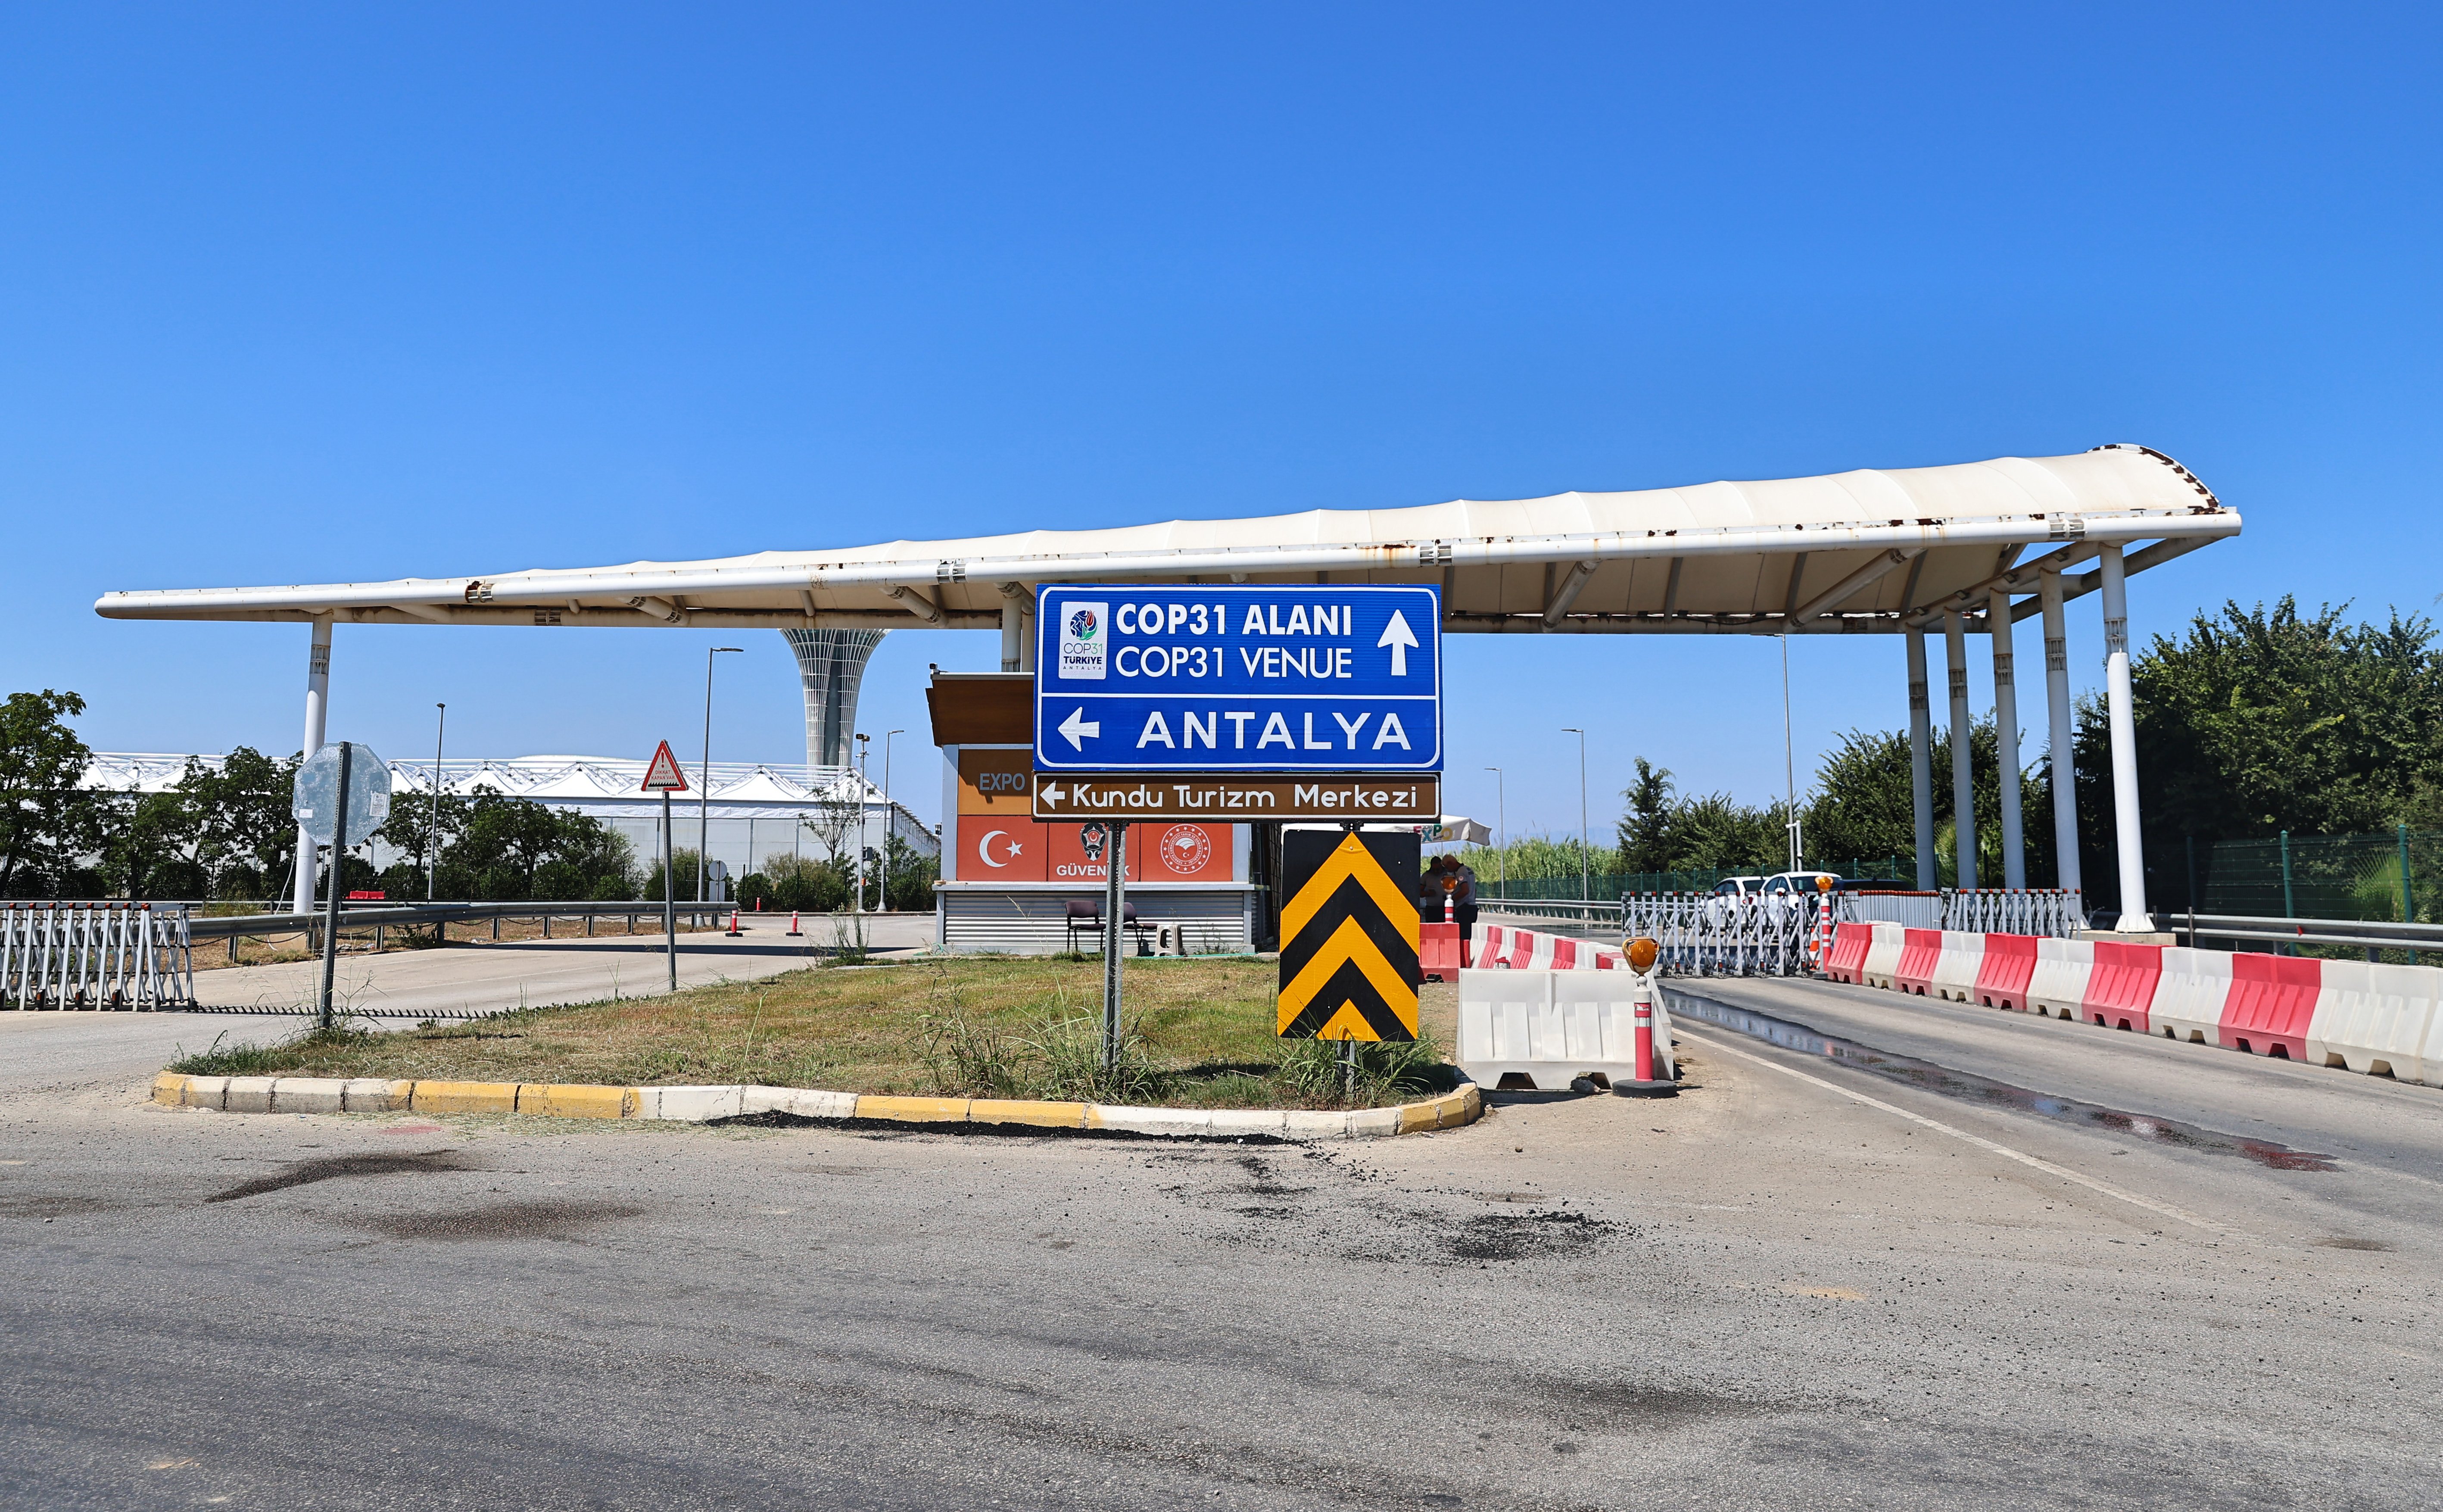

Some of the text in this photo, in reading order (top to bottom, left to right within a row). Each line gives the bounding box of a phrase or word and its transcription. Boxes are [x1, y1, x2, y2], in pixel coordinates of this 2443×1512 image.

[1117, 604, 1351, 636] COP31 ALANI
[1064, 643, 1103, 654] COP31
[1116, 646, 1351, 678] COP31 VENUE
[1136, 712, 1411, 750] ANTALYA
[980, 773, 1025, 791] EXPO
[1073, 784, 1416, 808] Kundu Turizm Merkezi
[1056, 863, 1130, 876] GÜVENK
